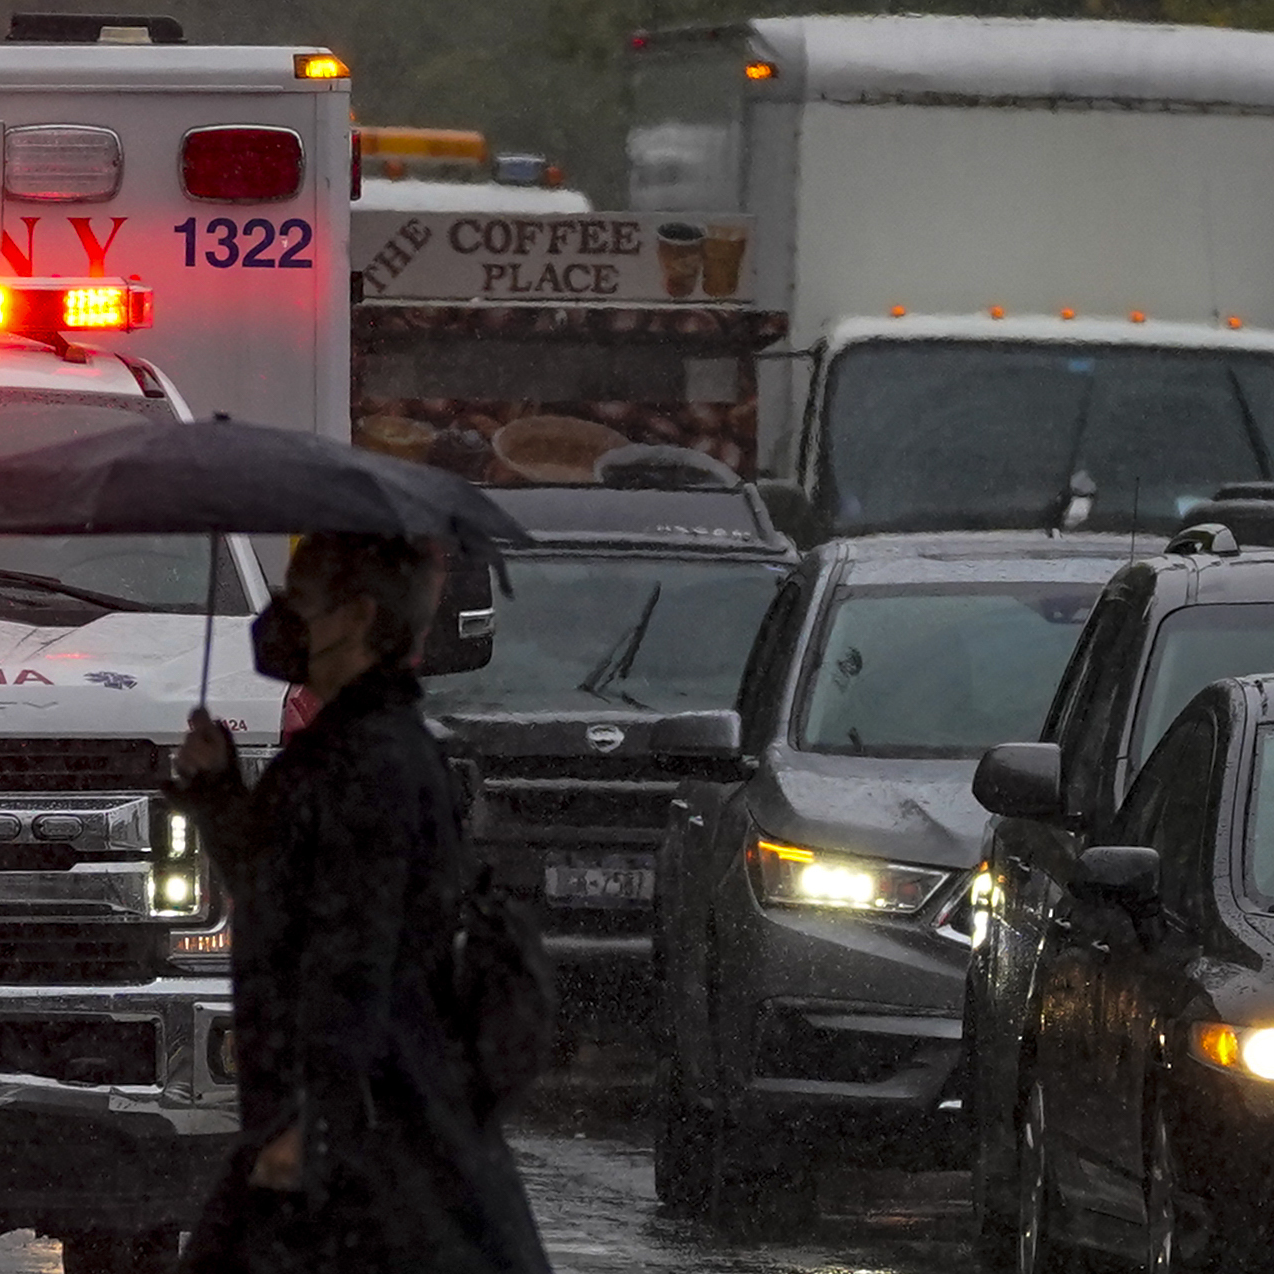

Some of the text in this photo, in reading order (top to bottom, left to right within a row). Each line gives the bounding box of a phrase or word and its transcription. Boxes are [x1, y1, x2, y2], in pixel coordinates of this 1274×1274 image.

[173, 217, 313, 268] 1322
[362, 217, 433, 294] THE
[447, 219, 642, 255] COFFEE
[482, 263, 619, 294] PLACE
